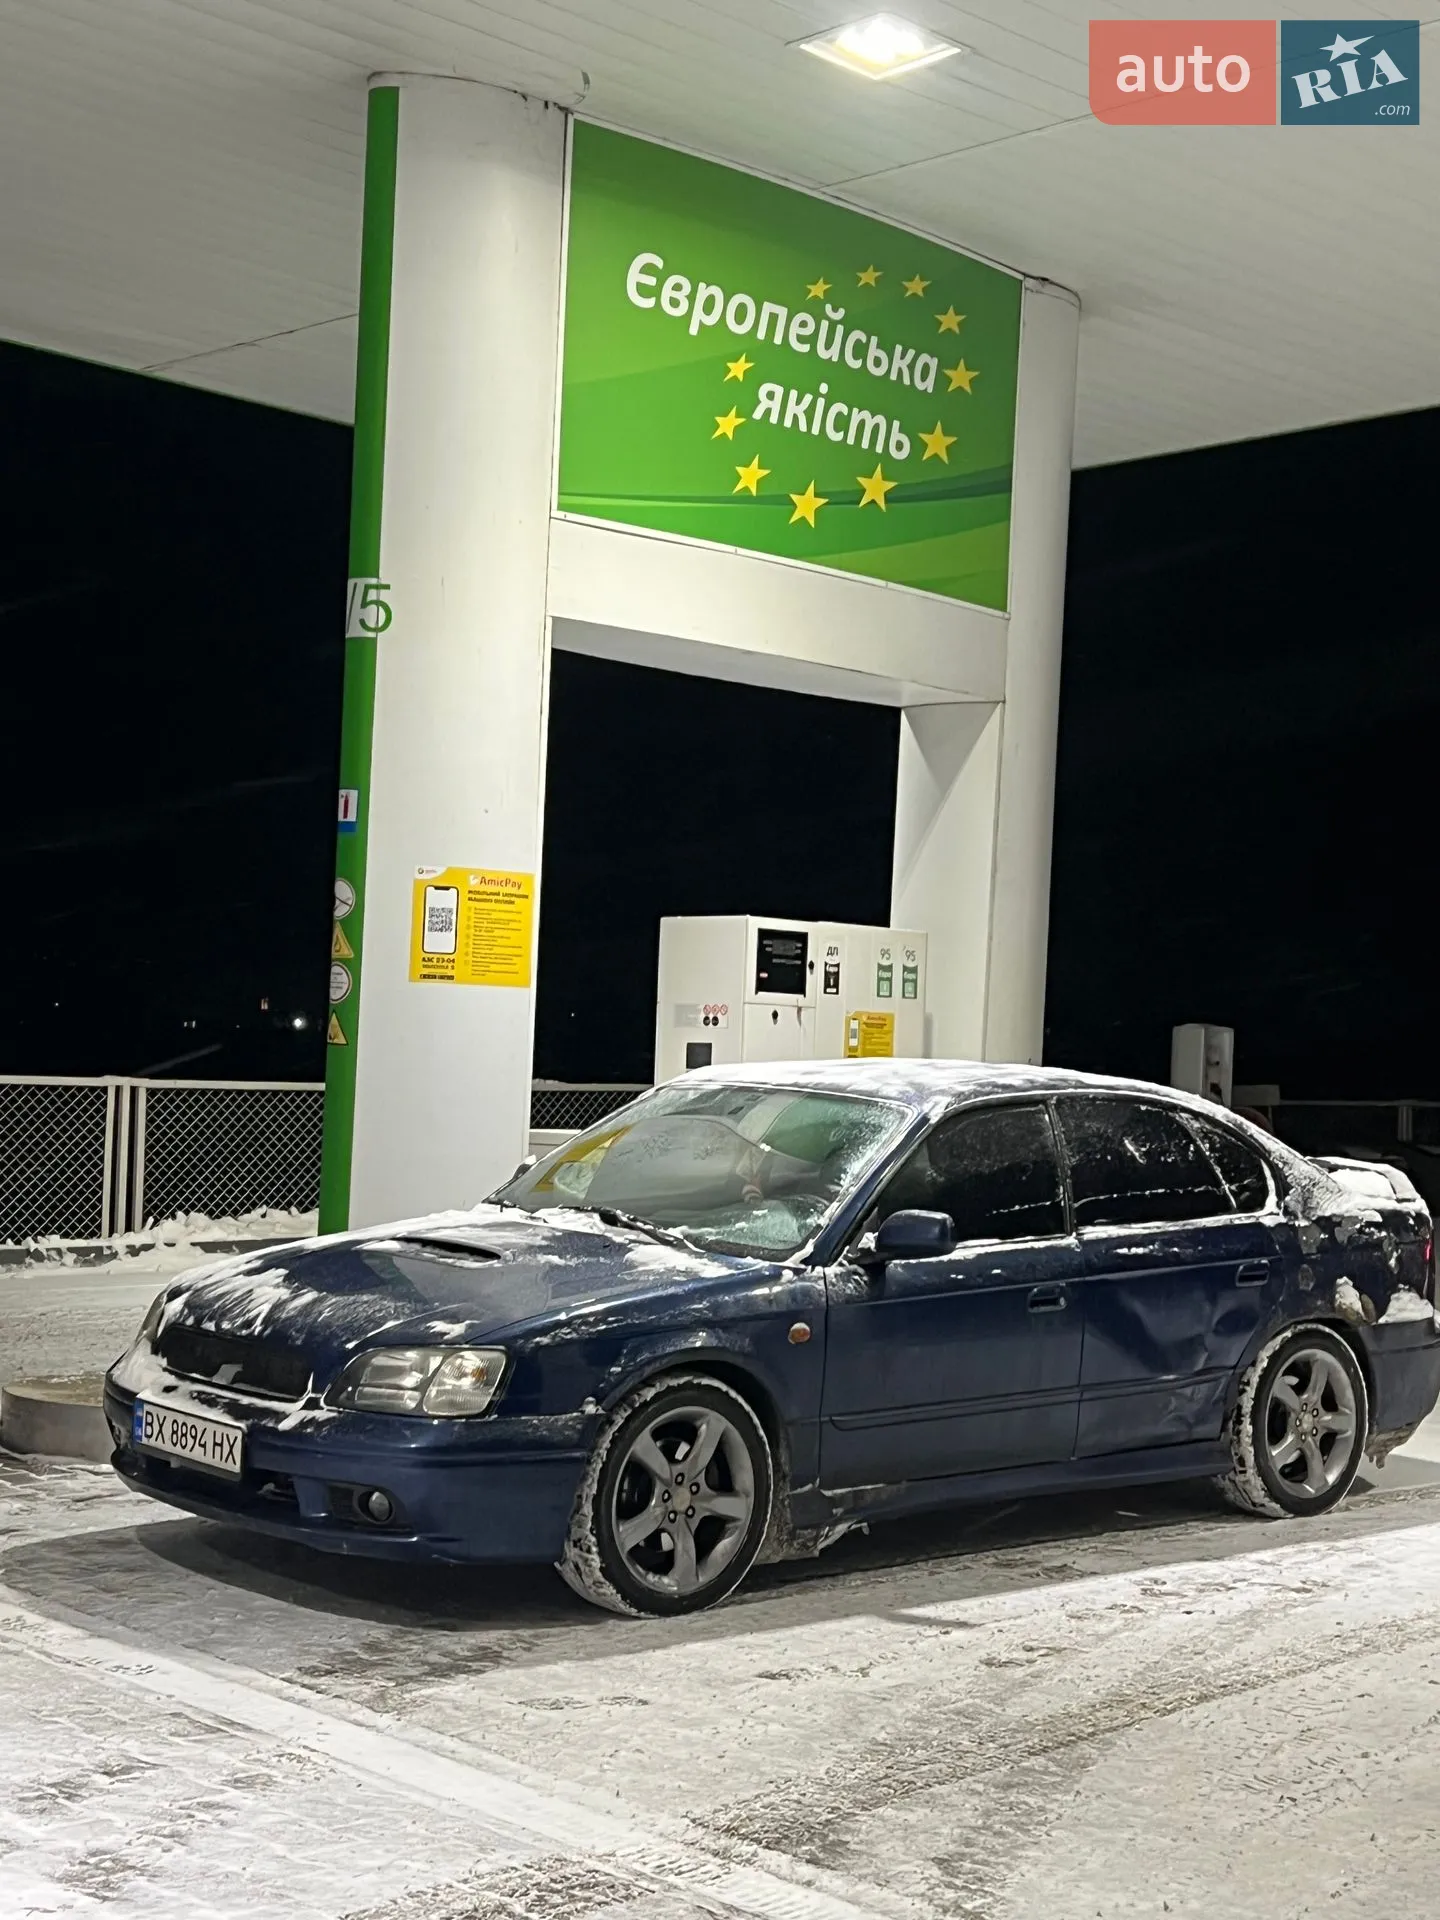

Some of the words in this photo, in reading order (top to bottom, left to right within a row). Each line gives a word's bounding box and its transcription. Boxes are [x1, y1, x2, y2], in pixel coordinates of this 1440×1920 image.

[625, 252, 939, 394] Європейська
[752, 382, 912, 461] якість
[479, 876, 522, 890] AmicPay
[880, 948, 892, 960] 95
[905, 950, 916, 962] 95
[144, 1410, 167, 1445] BX
[170, 1418, 207, 1457] 8894
[212, 1430, 238, 1466] HX
